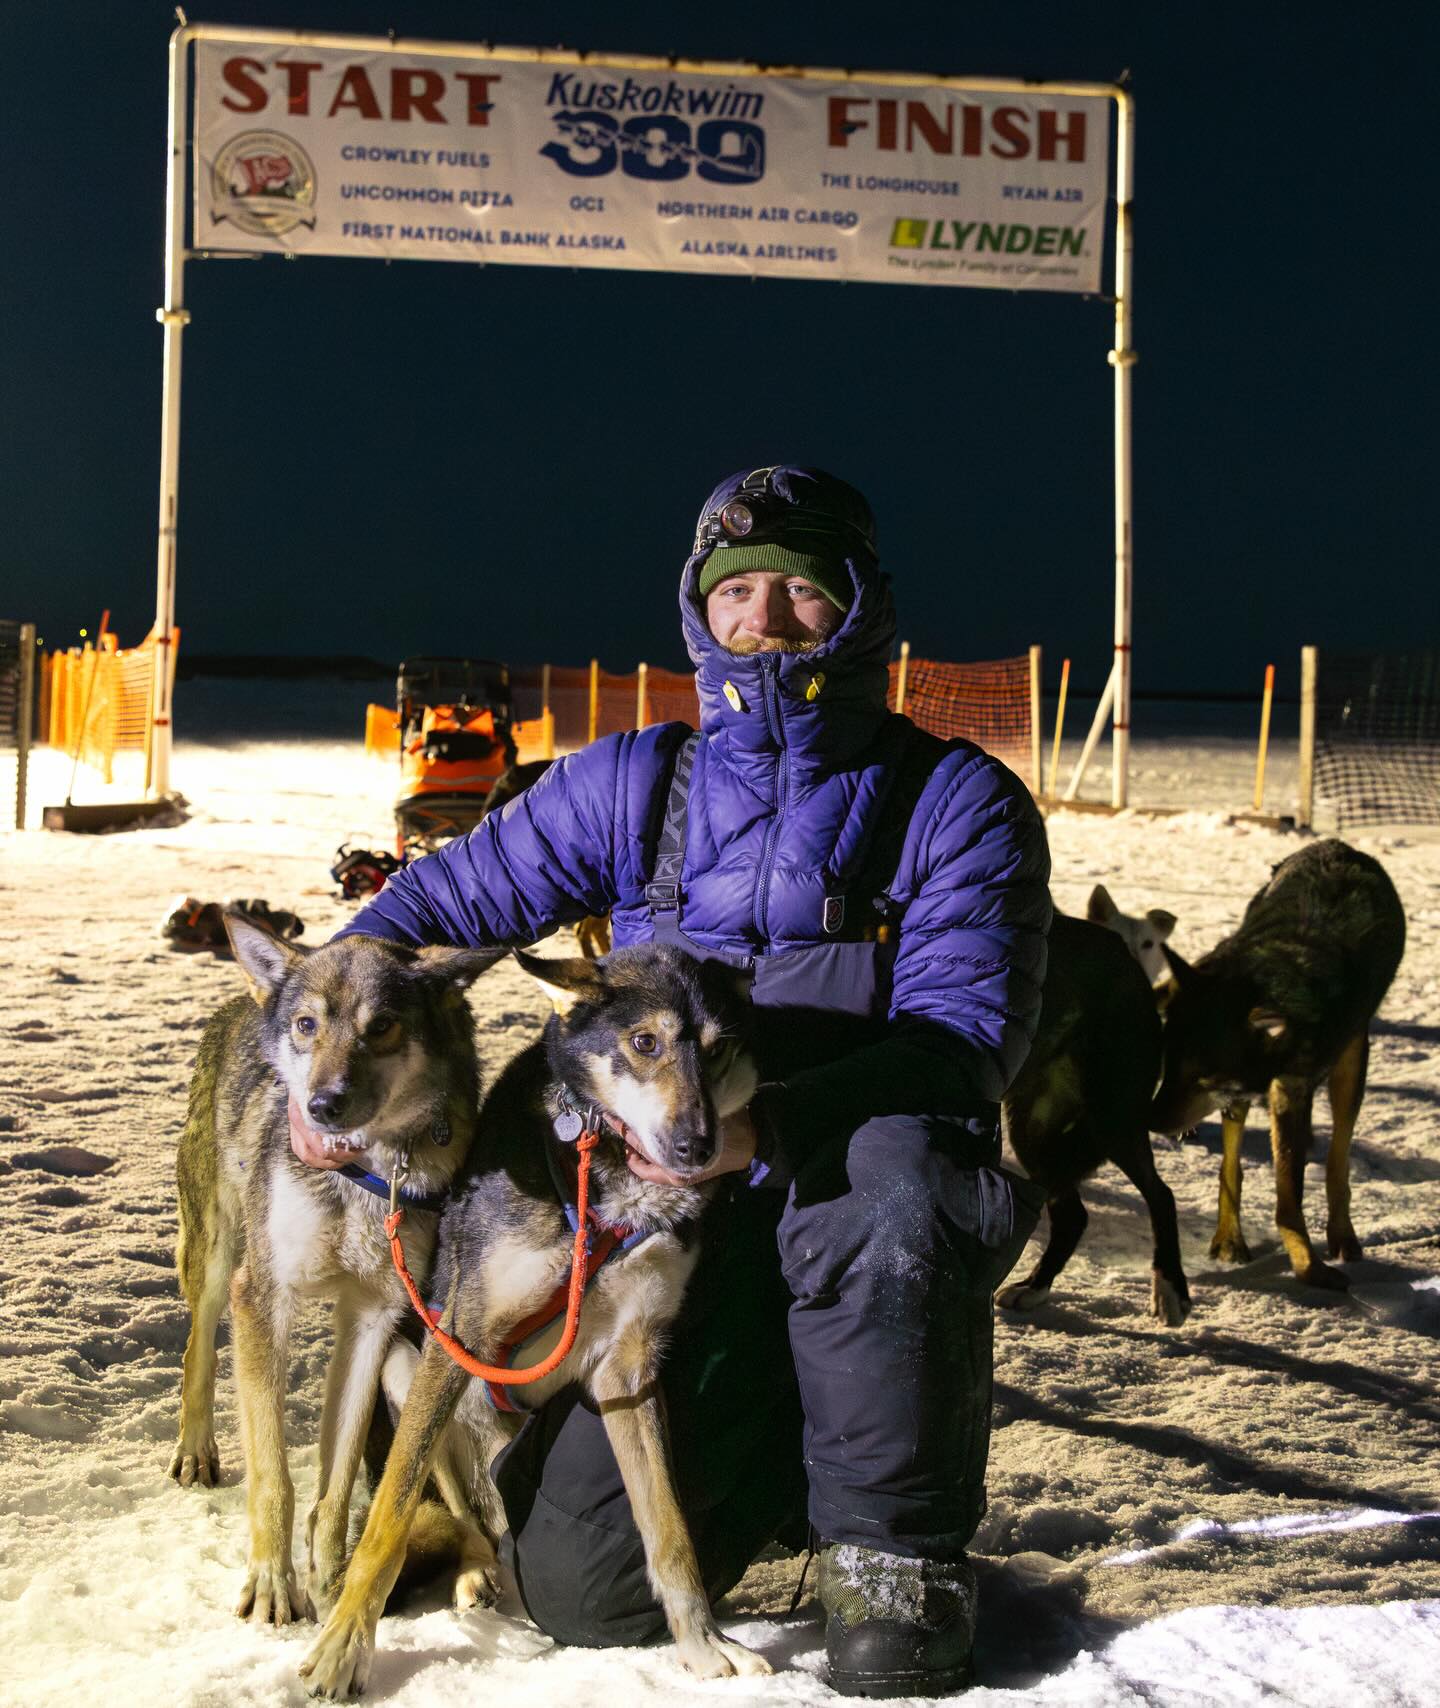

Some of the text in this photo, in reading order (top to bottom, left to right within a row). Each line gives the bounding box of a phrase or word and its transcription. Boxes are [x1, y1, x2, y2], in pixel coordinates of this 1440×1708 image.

[221, 57, 502, 127] START
[547, 71, 764, 119] Kuskokwim
[828, 96, 1086, 163] FINISH
[341, 146, 490, 169] CROWLEY FUELS
[340, 185, 514, 209] UNCOMMON PIZZA
[821, 173, 960, 197] THE LONGHOUSE
[1002, 185, 1084, 203] RYAN AIR
[657, 201, 859, 227] NORTHERN AIR CARGO
[342, 222, 626, 251] FIRST NATIONAL BANK ALASKA
[929, 219, 1086, 257] LYNDEN
[681, 240, 838, 262] ALASKA AIRLINES
